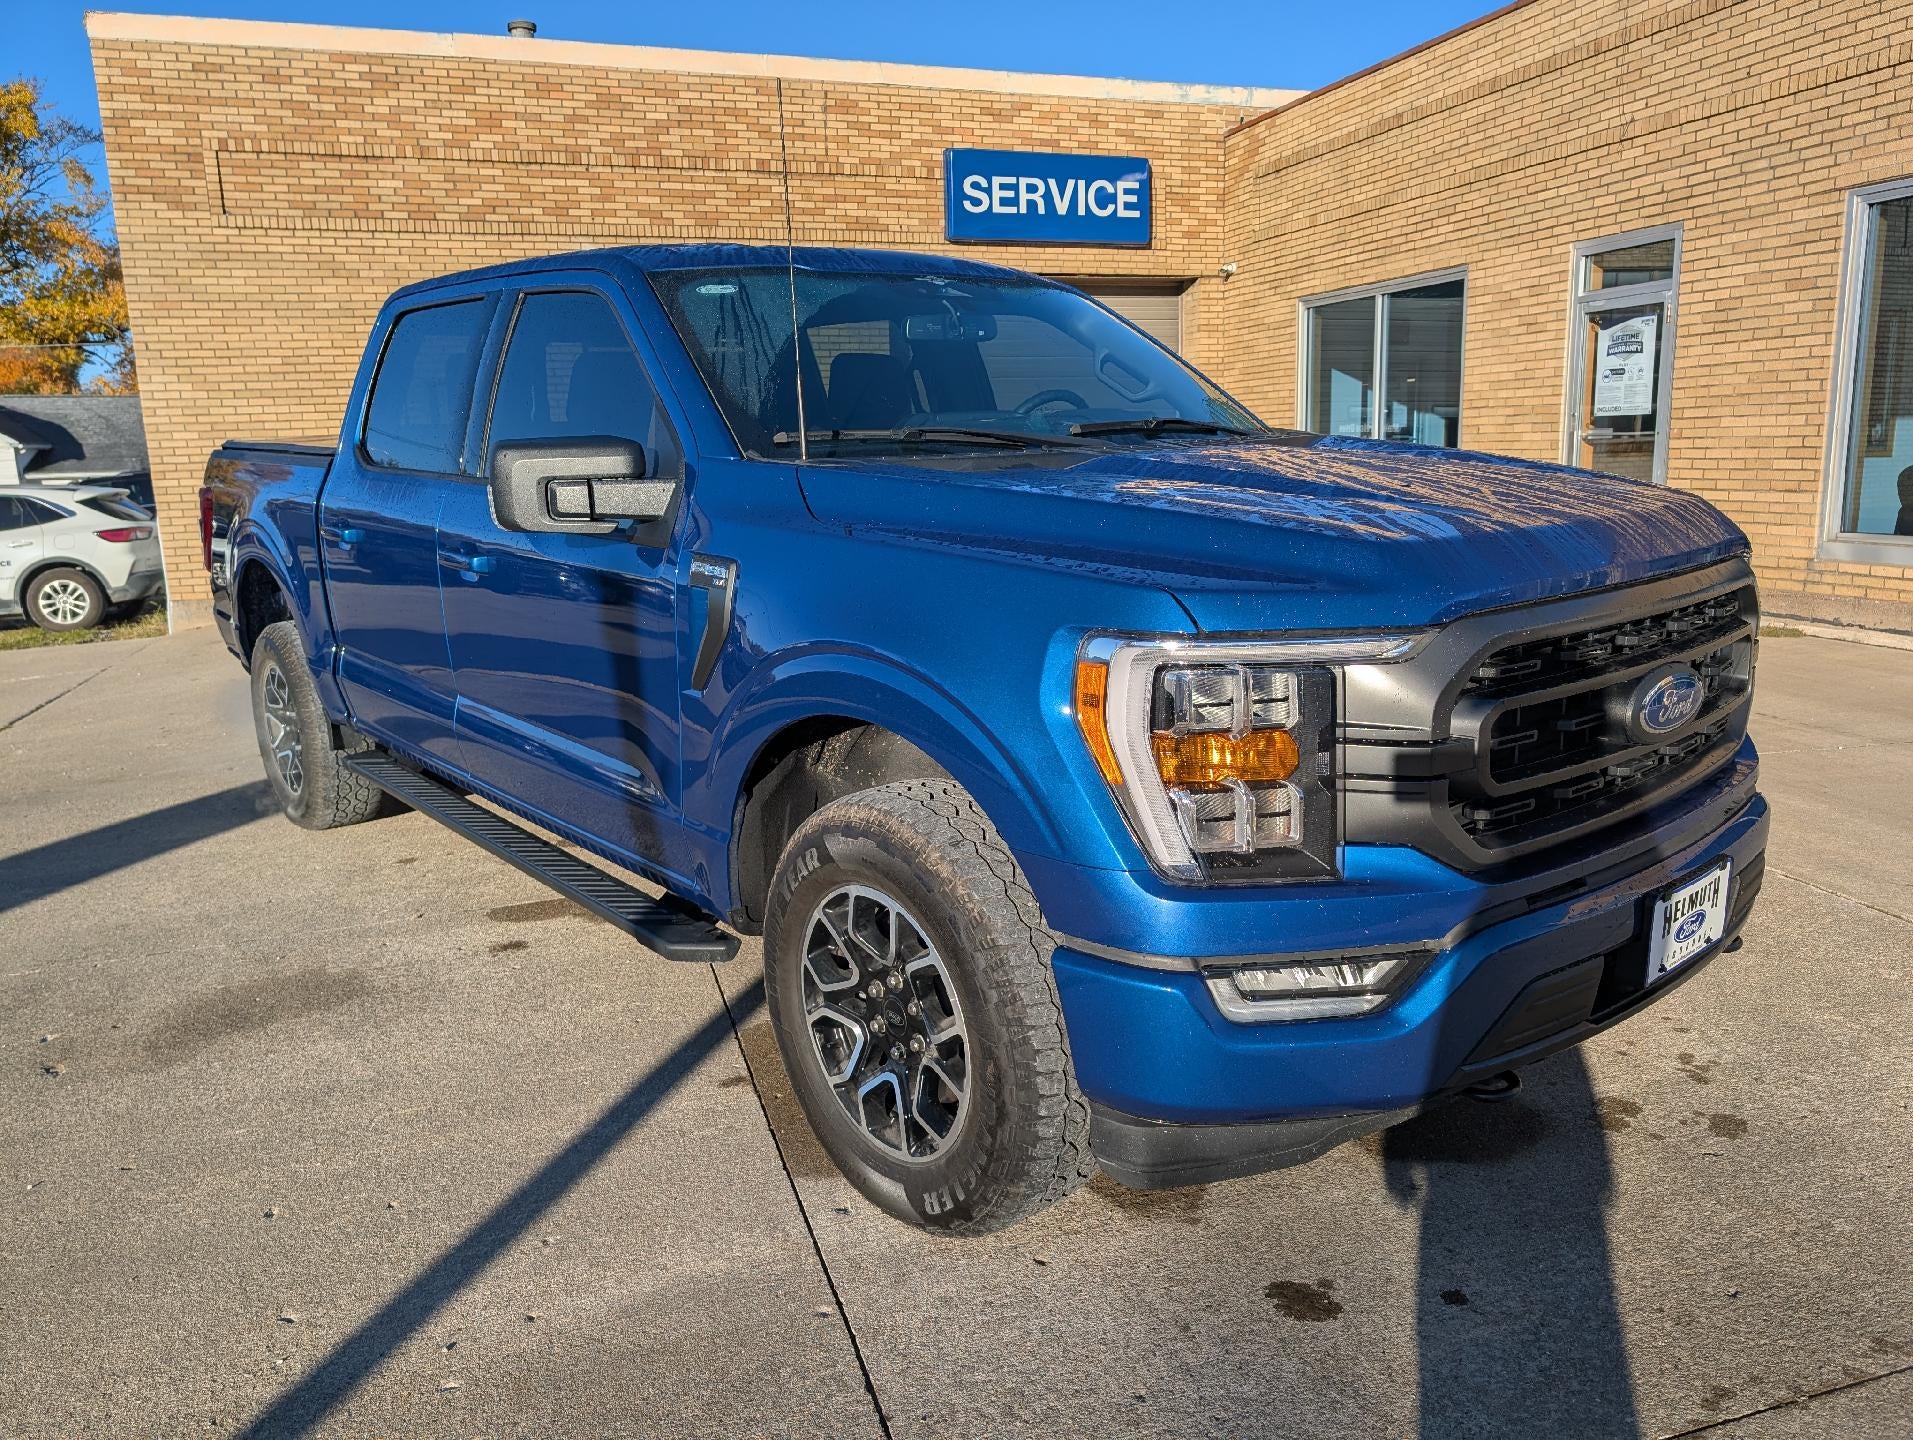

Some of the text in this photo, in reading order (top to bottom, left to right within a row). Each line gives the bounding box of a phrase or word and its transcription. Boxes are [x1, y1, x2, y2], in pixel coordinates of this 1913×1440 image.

[962, 174, 1141, 218] SERVICE
[1608, 345, 1642, 354] WARRANTY
[1611, 332, 1640, 342] LIFETIME
[1597, 405, 1622, 413] INCLUDED
[1658, 689, 1695, 723] Ford
[1662, 875, 1721, 939] HELMUTH
[1679, 914, 1703, 939] Ford
